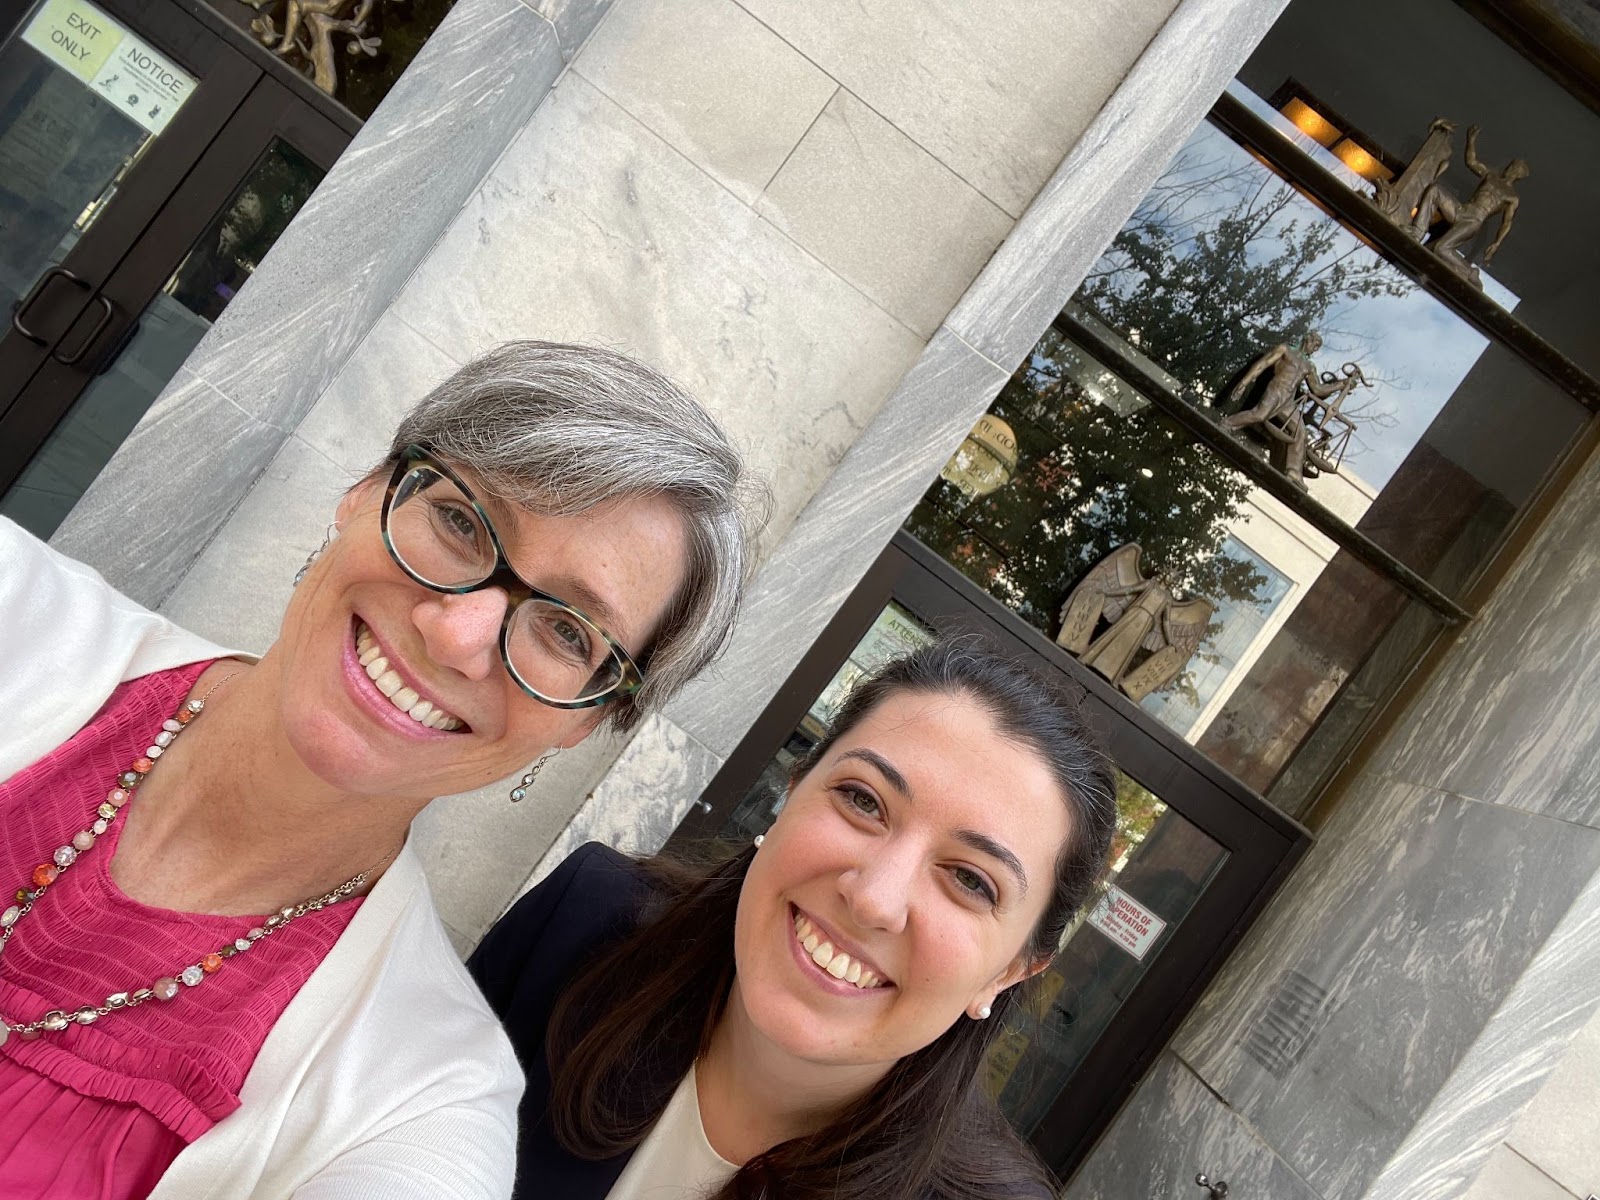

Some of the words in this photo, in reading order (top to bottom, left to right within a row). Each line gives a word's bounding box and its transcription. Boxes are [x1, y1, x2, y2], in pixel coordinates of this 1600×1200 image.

[66, 12, 101, 40] EXIT
[51, 30, 91, 60] ONLY
[127, 48, 183, 94] NOTICE
[1133, 681, 1143, 690] X
[1116, 896, 1142, 920] HOURS
[1141, 915, 1152, 926] OF
[1124, 928, 1139, 942] Friday
